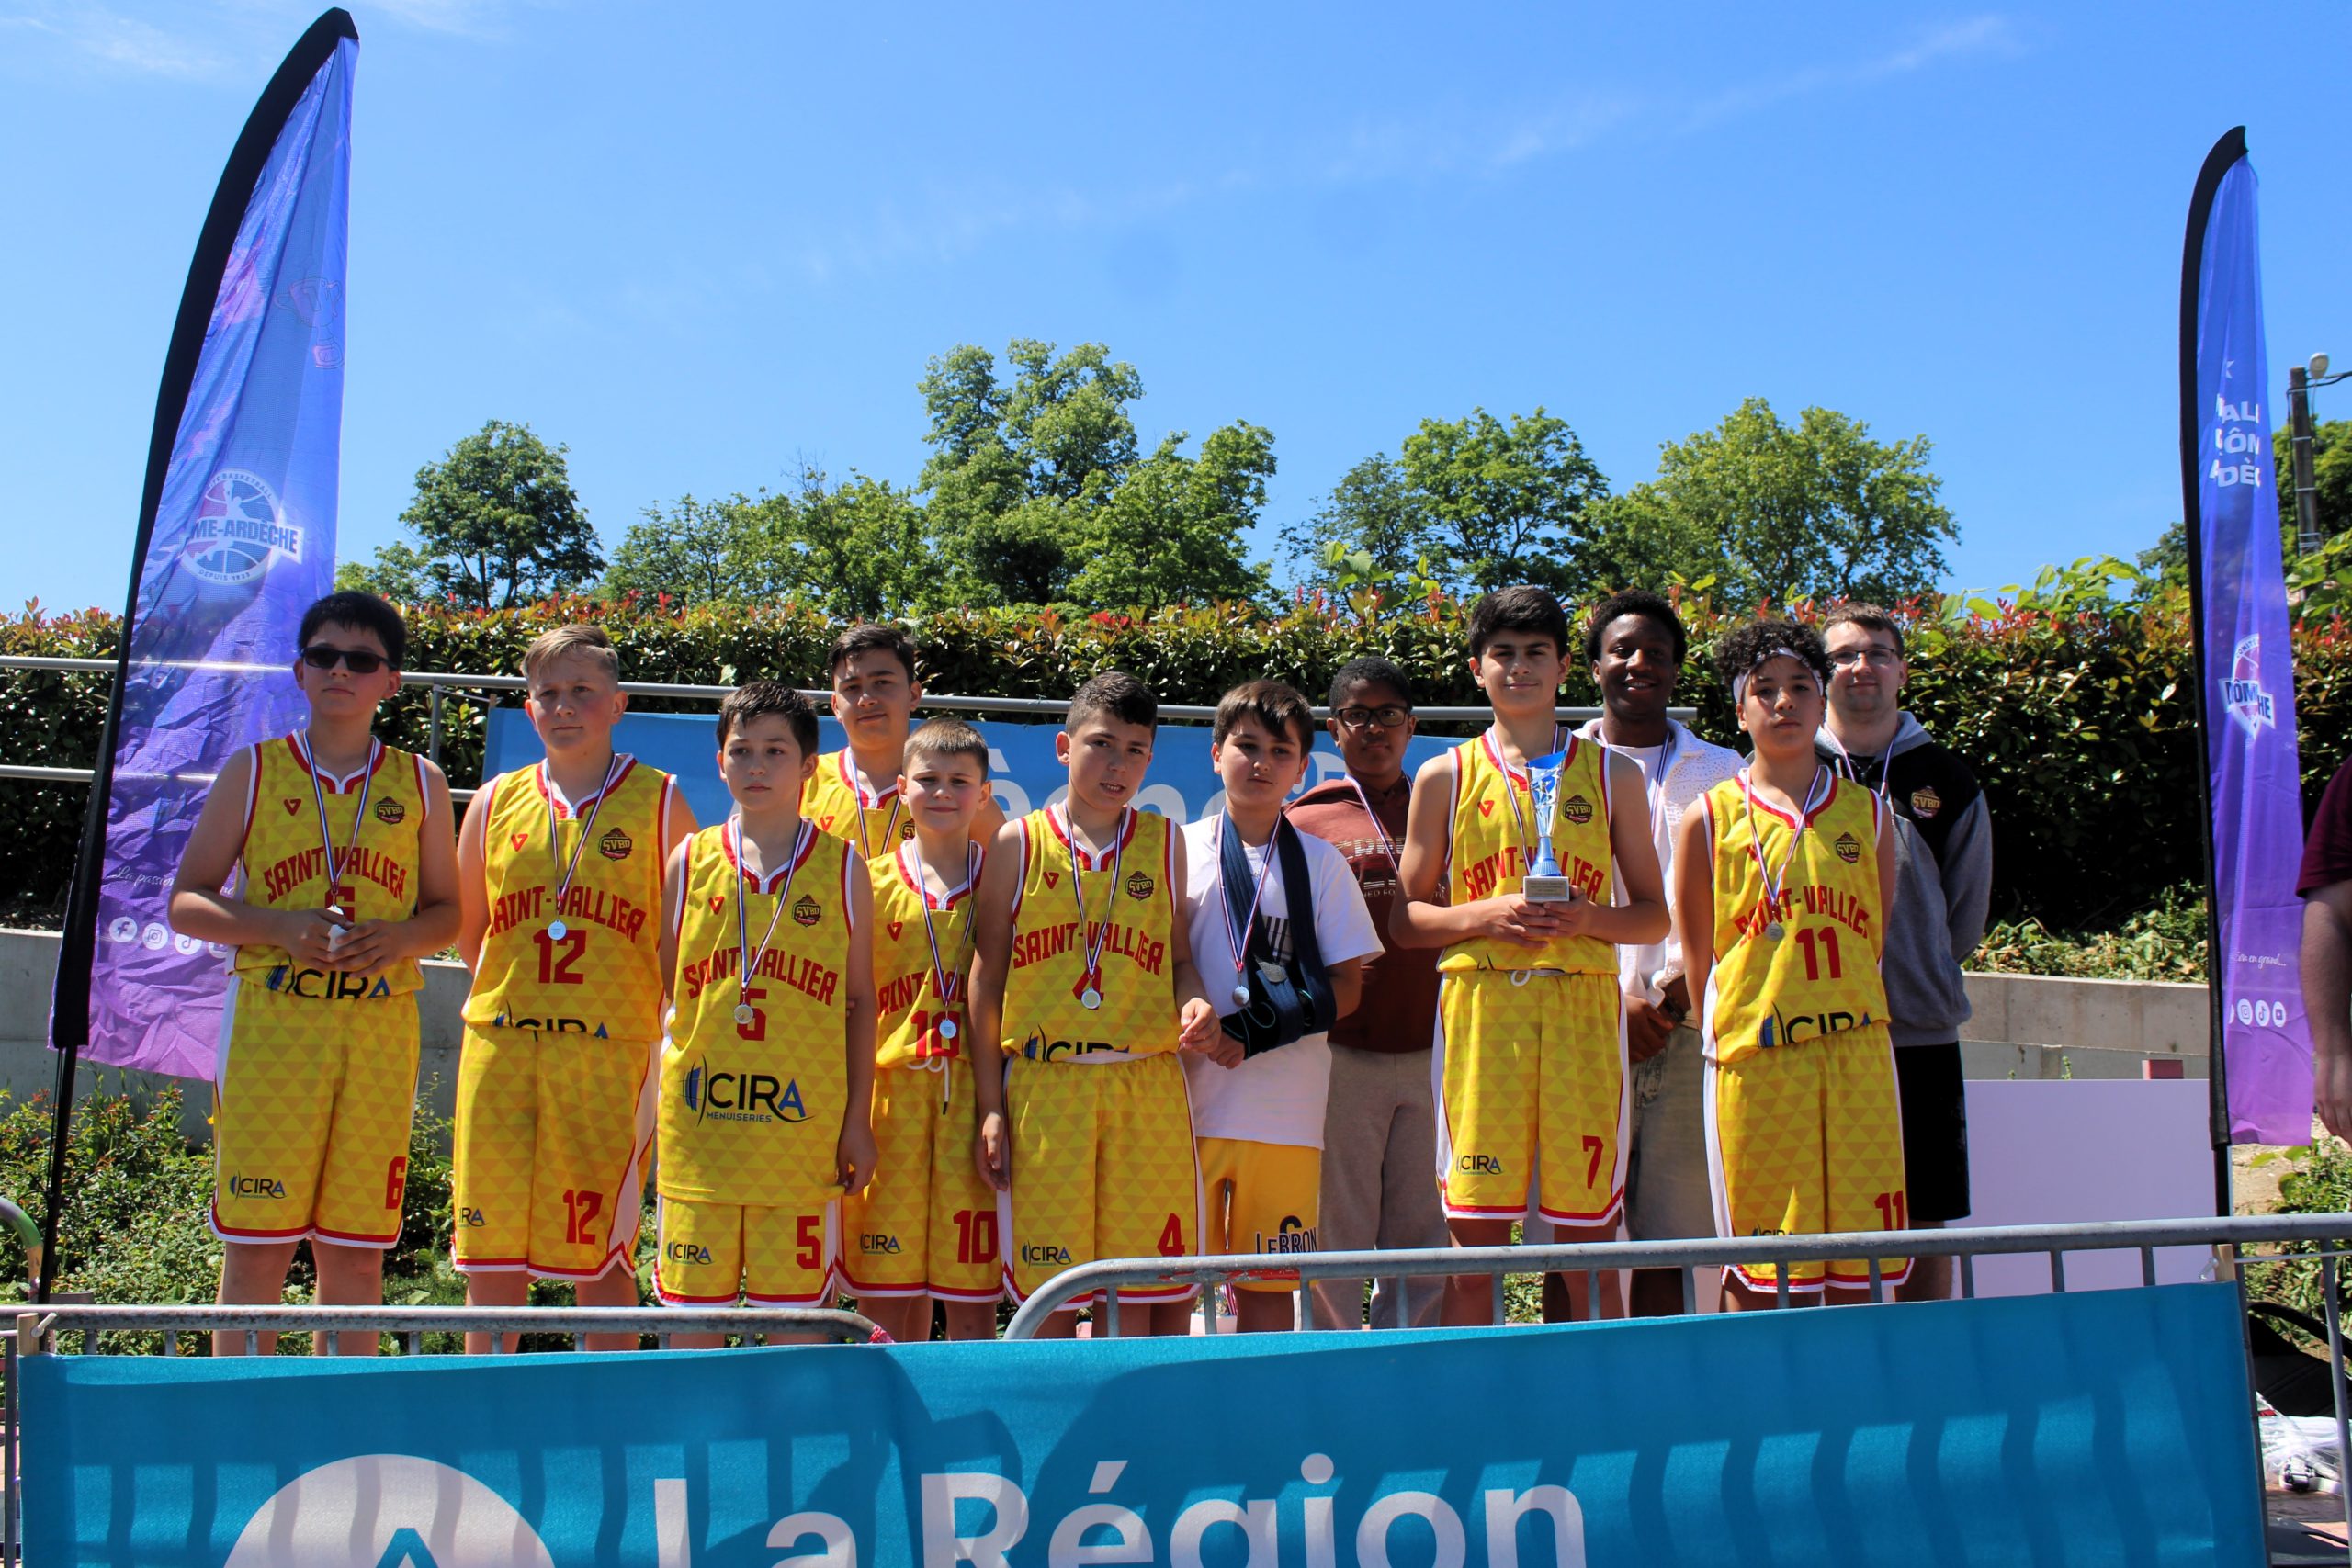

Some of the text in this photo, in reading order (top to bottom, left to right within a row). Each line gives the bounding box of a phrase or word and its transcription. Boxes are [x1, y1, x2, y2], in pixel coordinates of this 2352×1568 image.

[196, 519, 299, 554] ME-ARDÈCHE
[489, 886, 647, 943] AINT-VALLIER
[533, 929, 587, 985] 12
[1013, 921, 1164, 976] SAINT-VALLIER
[1794, 926, 1842, 981] 11
[910, 1010, 960, 1058] 10
[706, 1111, 773, 1123] MENUISERIES
[707, 1072, 816, 1123] CIRA
[240, 1177, 287, 1199] CIRA
[385, 1156, 407, 1210] 6
[1461, 1155, 1504, 1175] CIRA
[1582, 1135, 1604, 1190] 7
[562, 1189, 604, 1245] 12
[1157, 1213, 1185, 1258] 4
[1874, 1190, 1904, 1231] 11
[674, 1244, 714, 1265] CIRA
[796, 1215, 821, 1269] 5
[862, 1233, 904, 1255] CIRA
[953, 1210, 998, 1264] 10
[1030, 1246, 1072, 1265] CIRA
[920, 1454, 1587, 1568] Région
